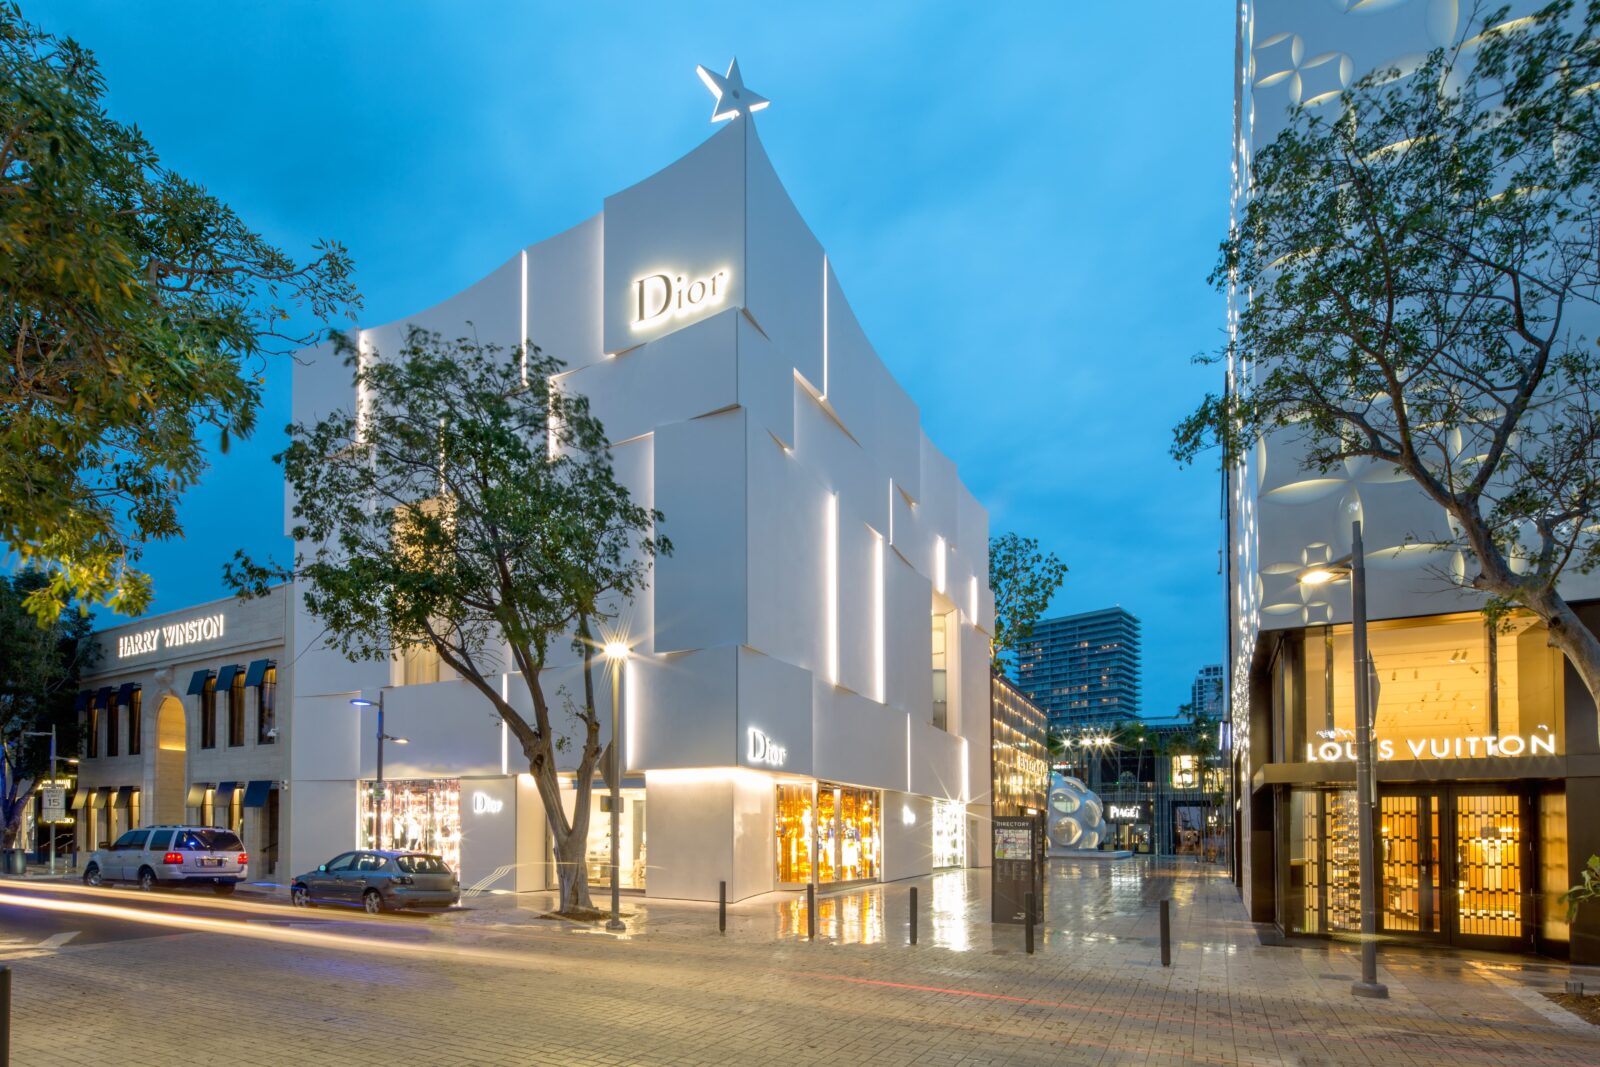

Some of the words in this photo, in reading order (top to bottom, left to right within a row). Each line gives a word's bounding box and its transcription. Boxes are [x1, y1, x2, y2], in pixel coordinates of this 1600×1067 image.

[631, 269, 726, 326] Dior
[118, 628, 160, 659] HARRY
[162, 613, 225, 648] WINSTON
[747, 727, 787, 766] Dior
[1306, 738, 1394, 762] LOUS
[1406, 733, 1556, 759] VUITTON
[48, 798, 61, 807] 15
[472, 791, 504, 815] Dior
[1110, 805, 1141, 819] PIAGET
